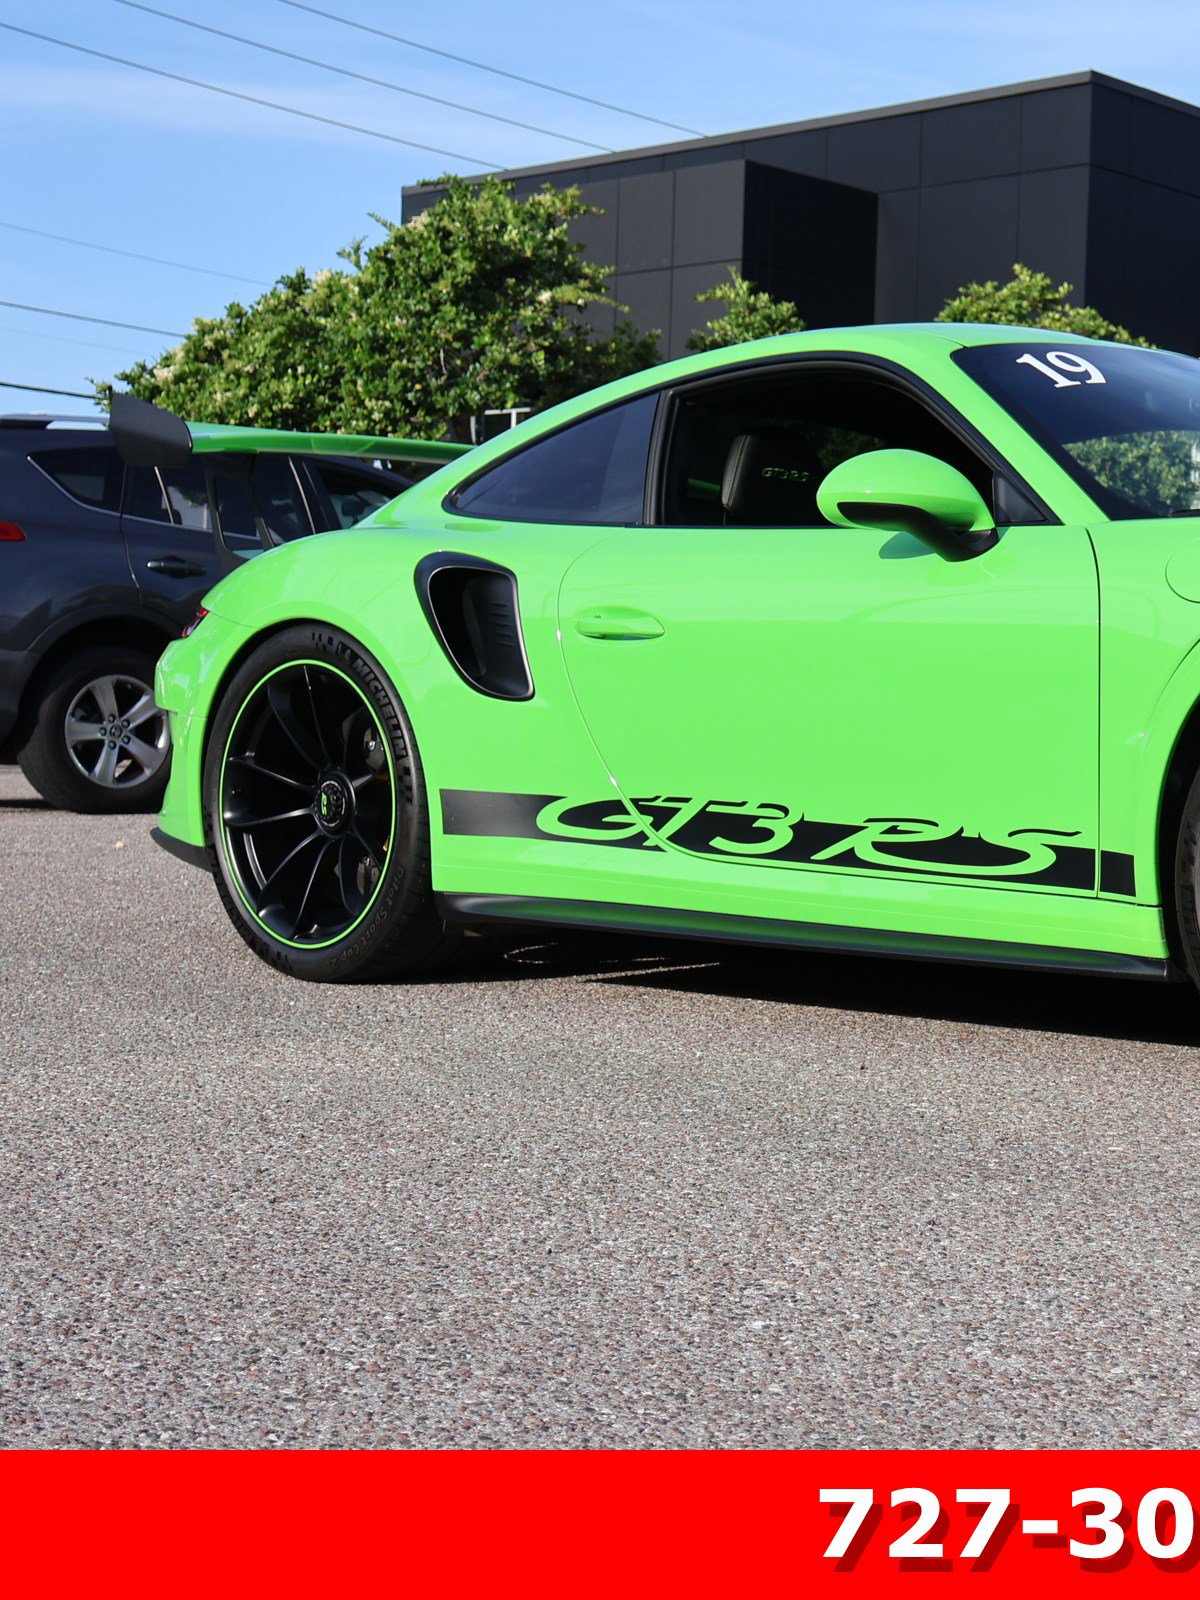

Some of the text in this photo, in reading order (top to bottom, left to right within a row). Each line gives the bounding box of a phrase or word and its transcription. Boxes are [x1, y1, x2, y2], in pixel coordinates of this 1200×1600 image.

[1015, 351, 1107, 388] 19
[353, 658, 407, 758] MICHELIN
[535, 794, 1082, 876] GT3 RS
